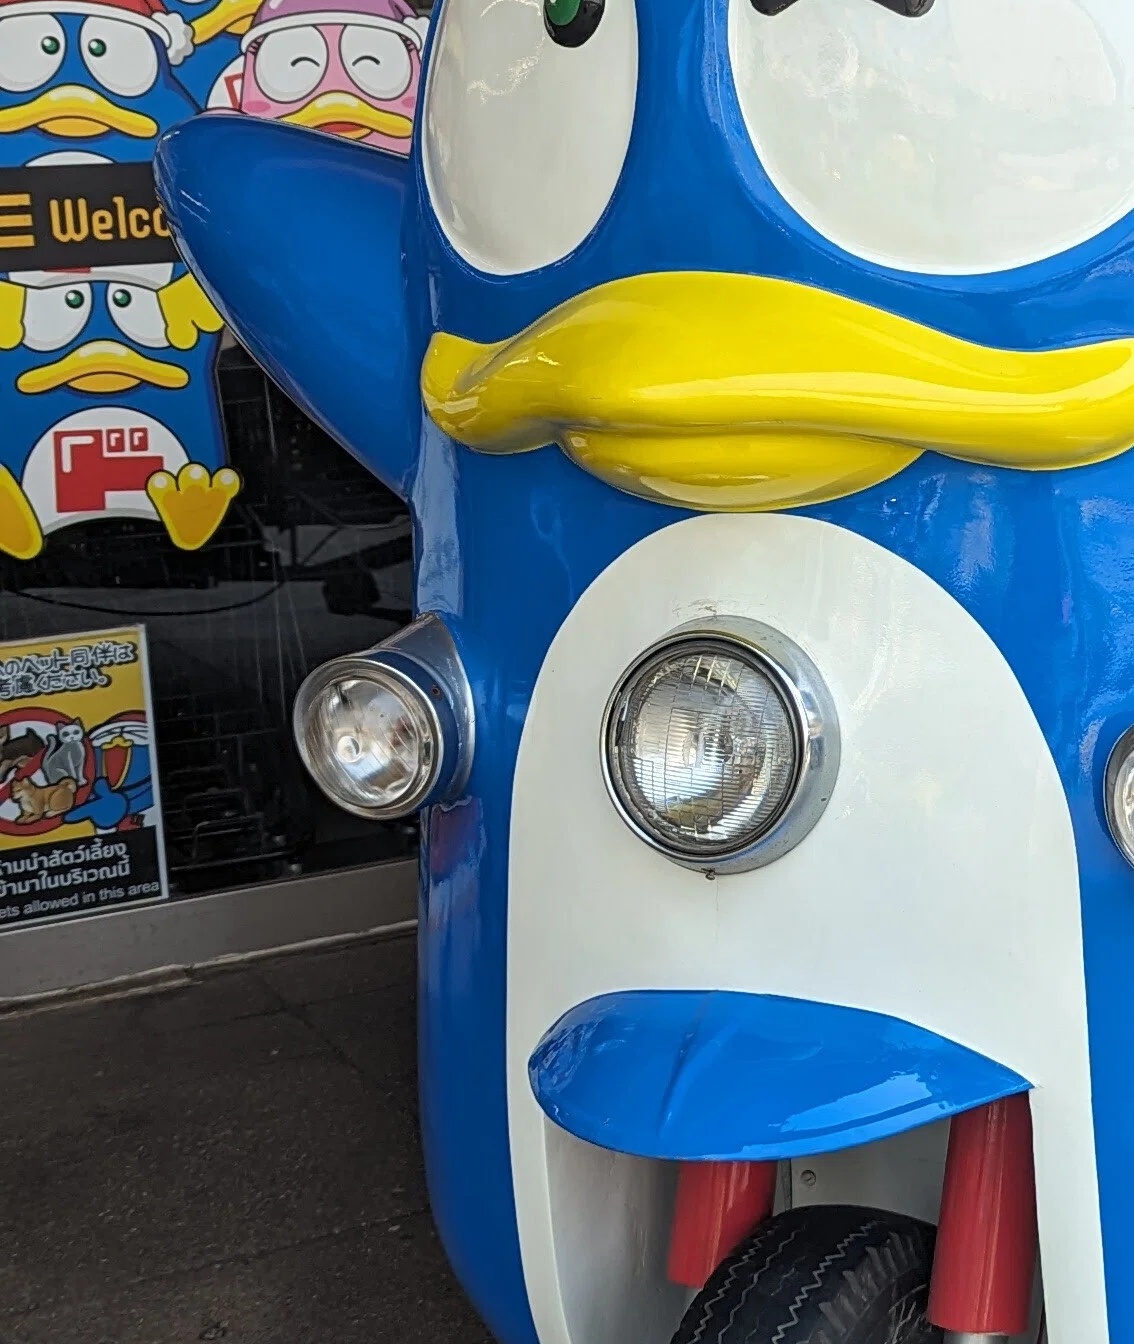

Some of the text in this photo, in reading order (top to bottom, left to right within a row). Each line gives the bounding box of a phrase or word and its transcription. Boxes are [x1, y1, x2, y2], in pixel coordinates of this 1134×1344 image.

[23, 893, 79, 915] allowed
[82, 891, 96, 903] in
[99, 886, 125, 901] this
[127, 881, 160, 896] area
